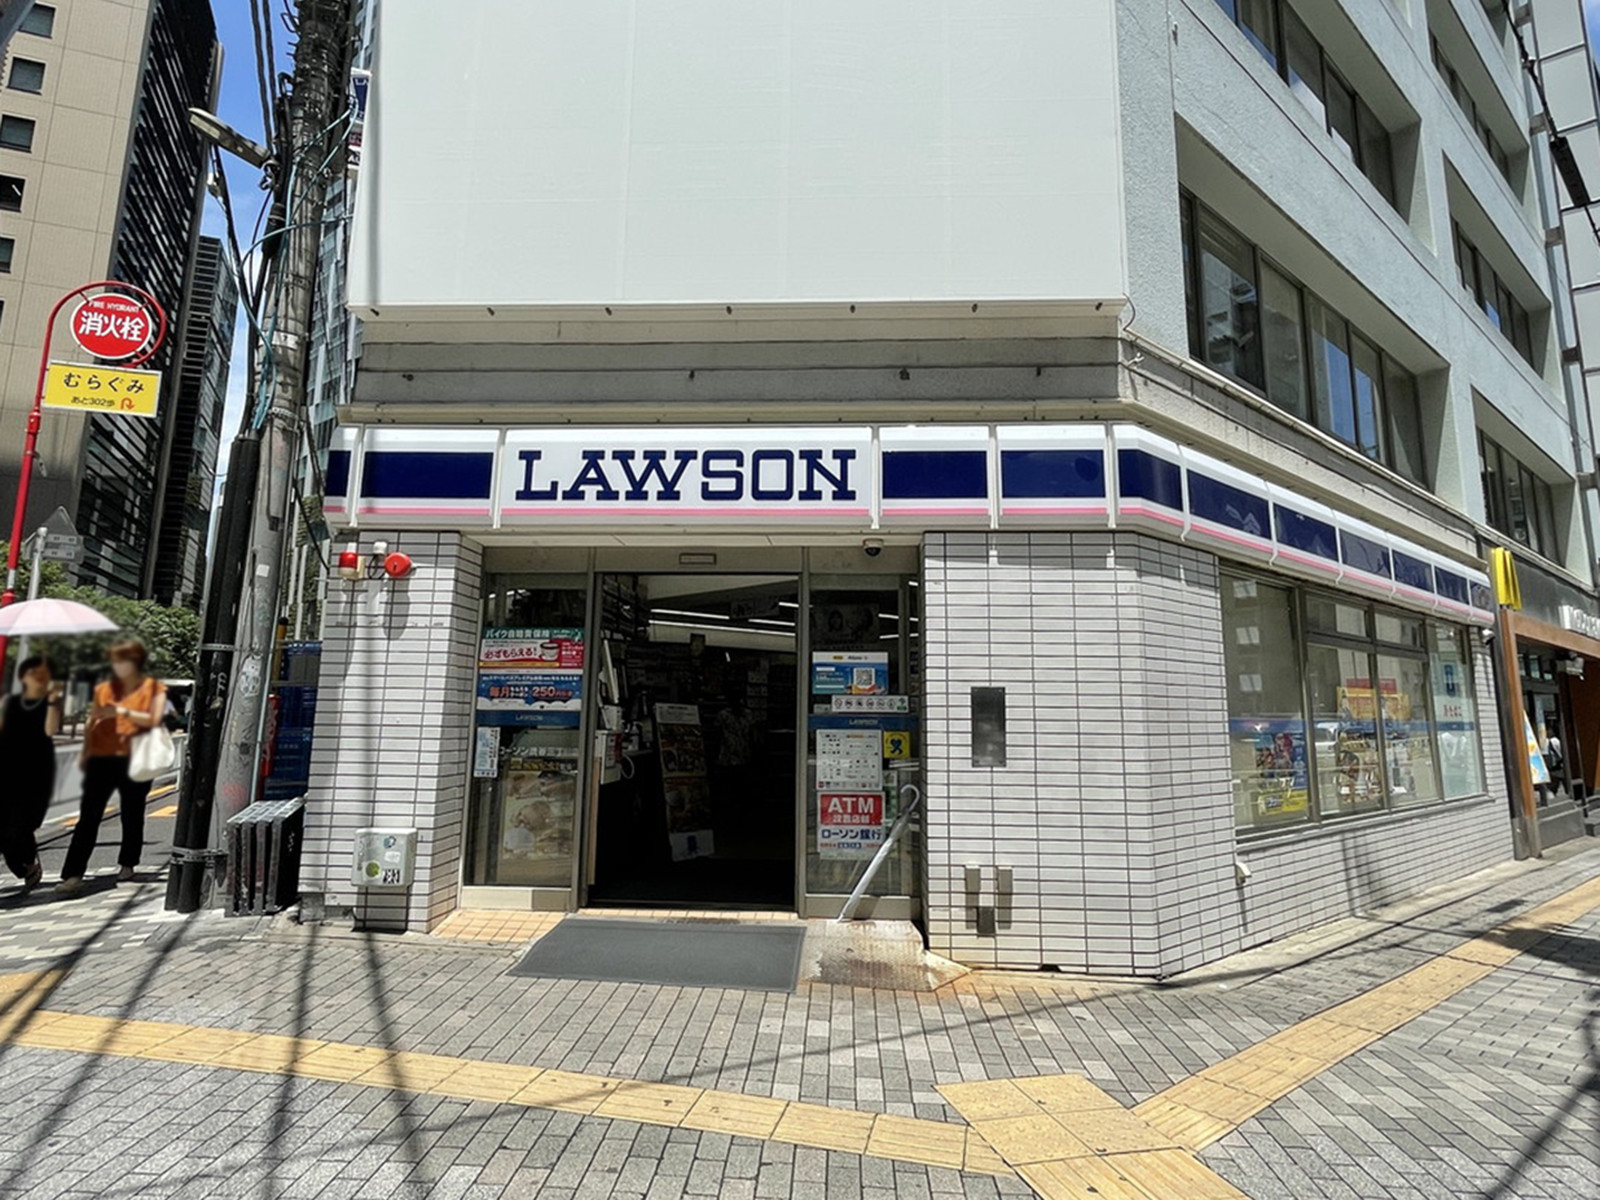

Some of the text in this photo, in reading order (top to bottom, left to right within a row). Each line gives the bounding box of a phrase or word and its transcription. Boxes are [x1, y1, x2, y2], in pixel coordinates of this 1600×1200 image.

[88, 300, 105, 309] FIRE
[78, 310, 145, 341] 消火栓
[63, 372, 145, 394] むらぐみ
[515, 449, 857, 501] LAWSON
[532, 686, 556, 698] 250
[827, 797, 874, 814] ATM
[821, 829, 881, 840] ローソン銀行
